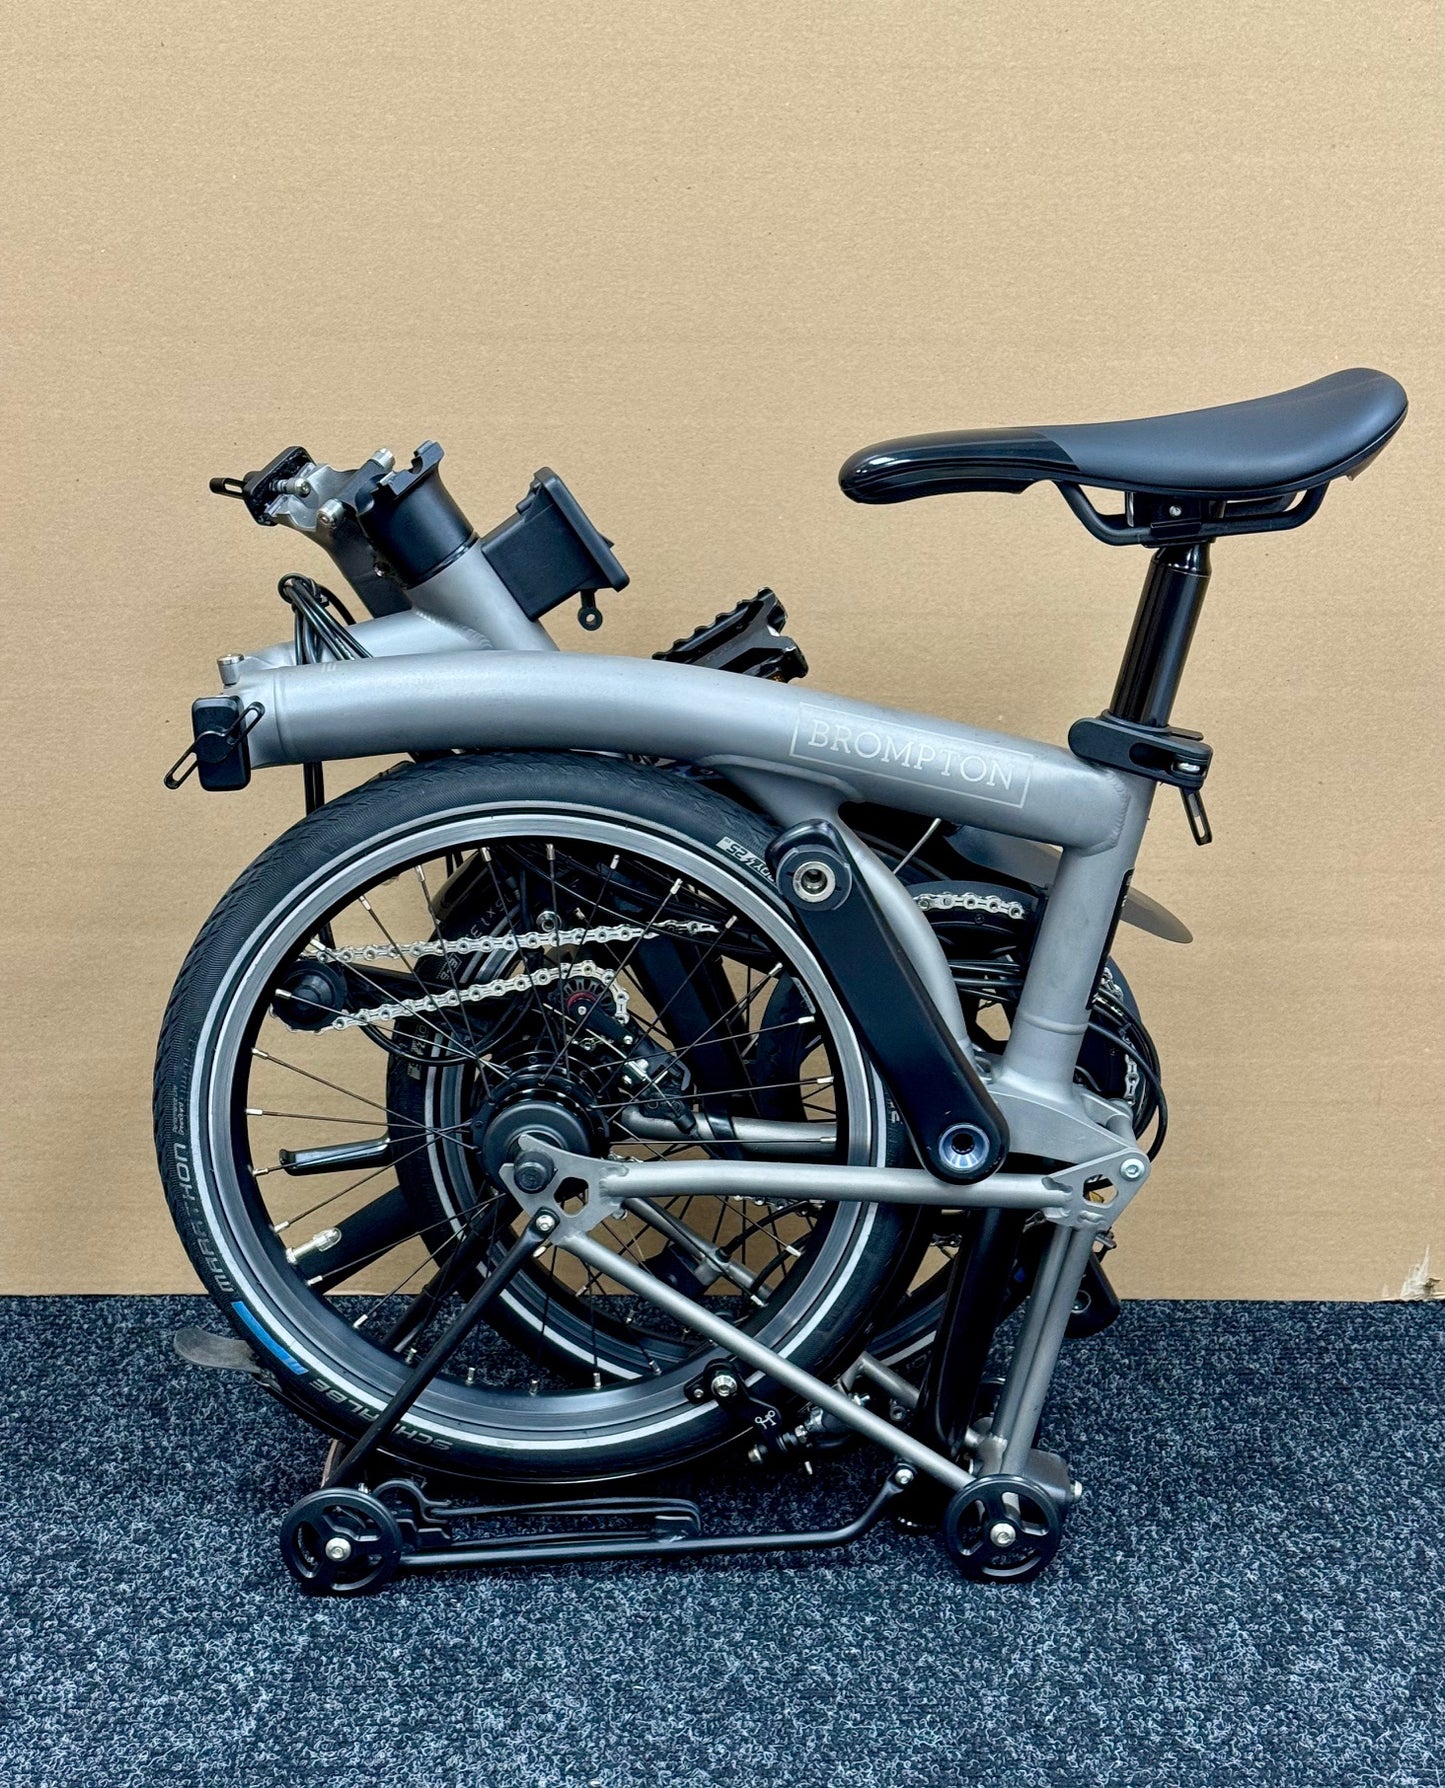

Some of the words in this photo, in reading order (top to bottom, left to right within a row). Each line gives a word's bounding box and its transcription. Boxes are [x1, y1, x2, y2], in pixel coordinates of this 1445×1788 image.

[808, 719, 1016, 791] BROMPTON
[727, 843, 749, 859] 25
[173, 1142, 234, 1293] MARATHON
[309, 1378, 453, 1451] SCHALBE
